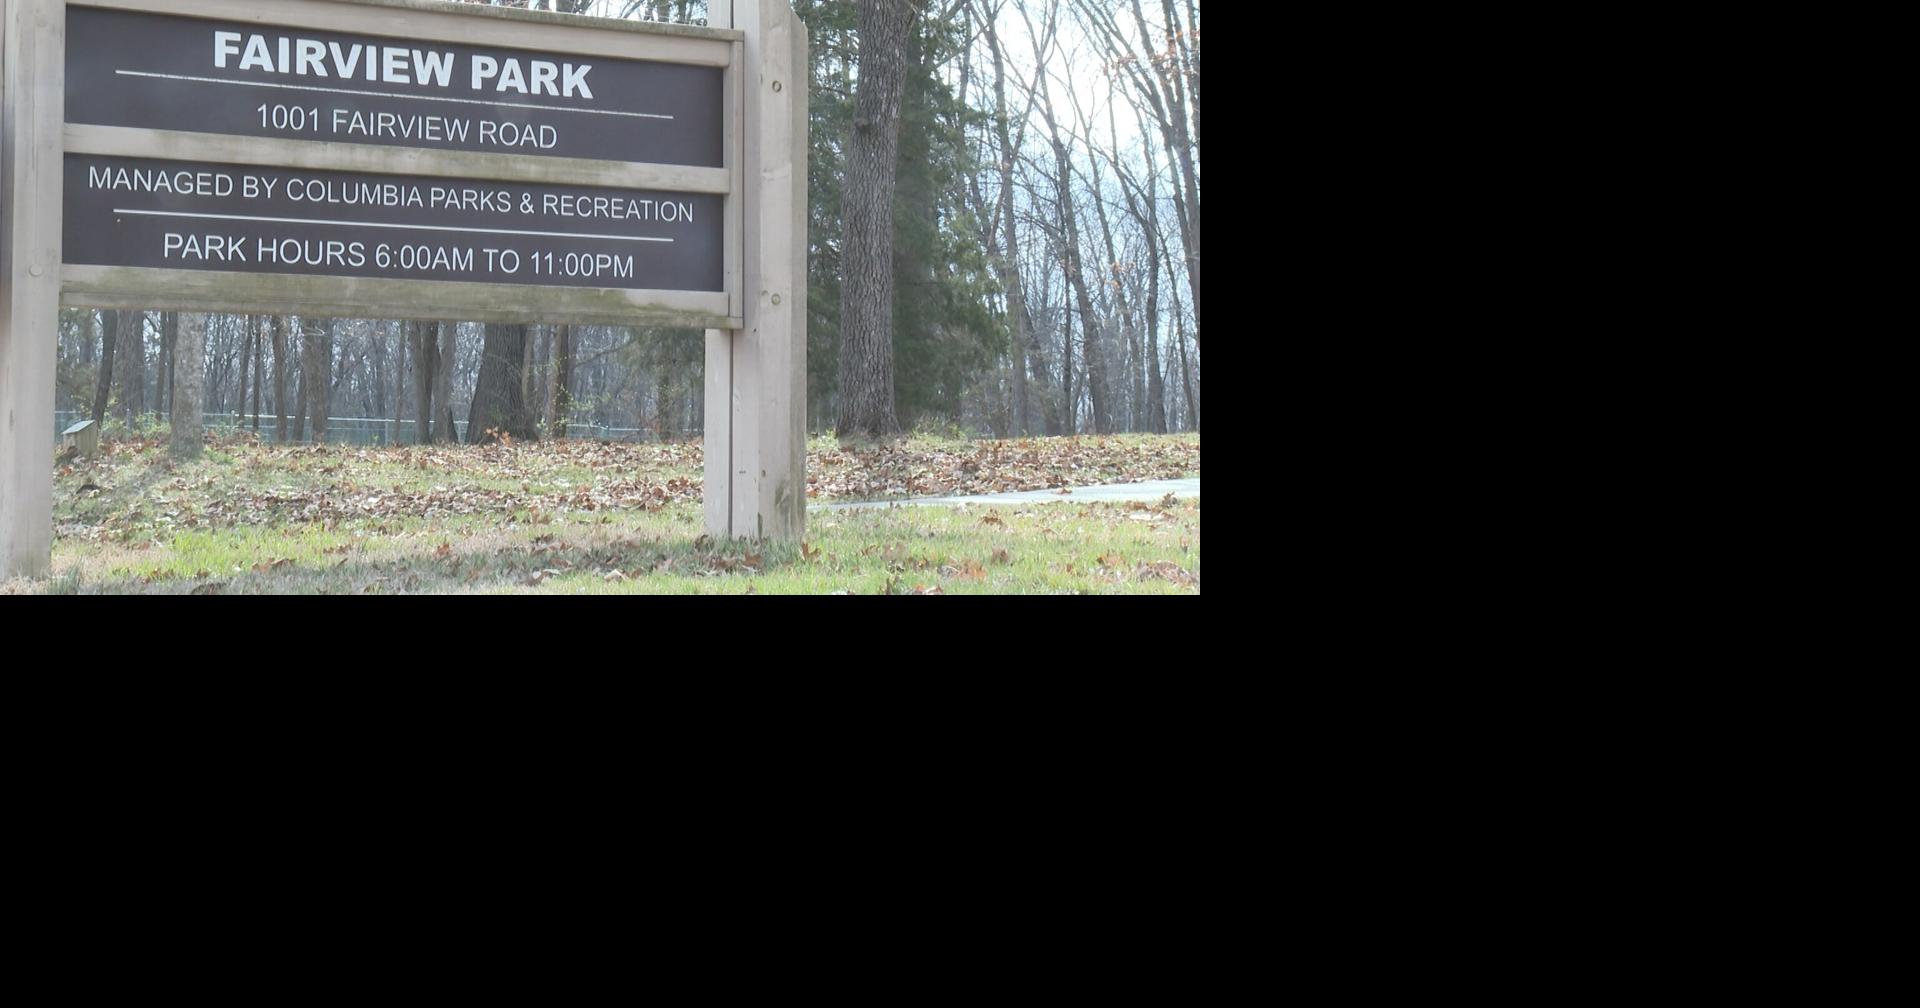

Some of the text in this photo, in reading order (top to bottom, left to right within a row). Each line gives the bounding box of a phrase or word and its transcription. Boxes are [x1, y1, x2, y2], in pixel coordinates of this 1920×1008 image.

[214, 30, 594, 100] FAIRVIEW PARK
[257, 103, 558, 149] 1001 FAIRVIEW ROAD
[89, 165, 693, 223] MANAGED BY COLUMBIA PARKS & RECREATION
[163, 232, 634, 279] PARK HOURS 6:00AM TO 11:00PM
